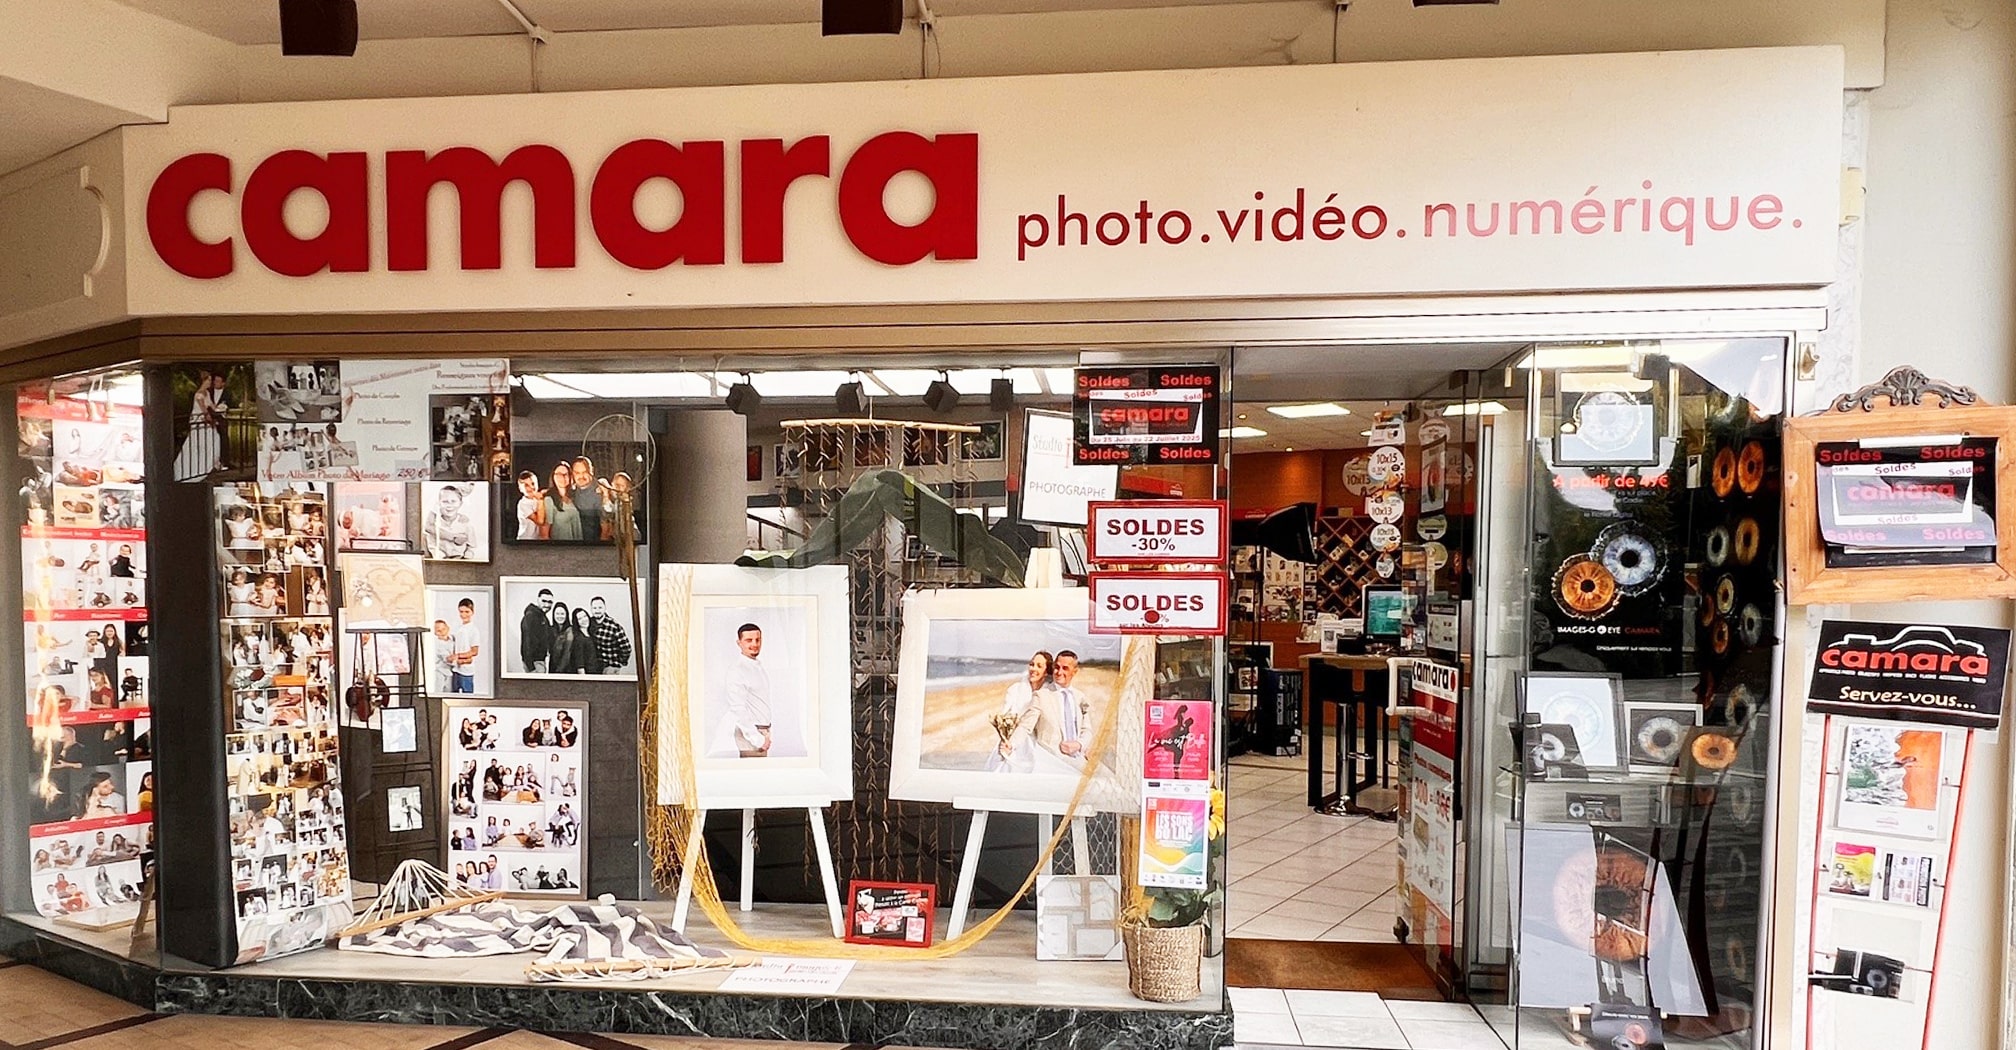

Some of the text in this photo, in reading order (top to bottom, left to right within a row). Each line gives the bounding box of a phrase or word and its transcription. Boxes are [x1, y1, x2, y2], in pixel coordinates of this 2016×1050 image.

[148, 131, 978, 278] camara
[1078, 375, 1130, 387] Soldes
[1160, 374, 1212, 386] Soldes
[1124, 389, 1158, 399] Soldes
[1101, 407, 1190, 423] camara
[1079, 448, 1129, 460] Soldes
[1160, 447, 1212, 460] Soldes
[1819, 450, 1882, 462] Soldes
[1920, 446, 1985, 459] Soldes
[1875, 463, 1917, 475] Soldes
[1614, 474, 1636, 487] de
[1029, 480, 1106, 499] PHOTOGRAPHE
[1847, 483, 1956, 501] camara
[1878, 514, 1918, 525] Soldes
[1106, 519, 1205, 536] SOLDES
[1825, 530, 1887, 542] Soldes
[1922, 528, 1985, 541] Soldes
[1131, 537, 1176, 551] -30%
[1106, 594, 1204, 612] SOLDES
[1821, 648, 1989, 675] camara
[1413, 660, 1449, 689] camara
[1839, 686, 1976, 709] Servez-vous...
